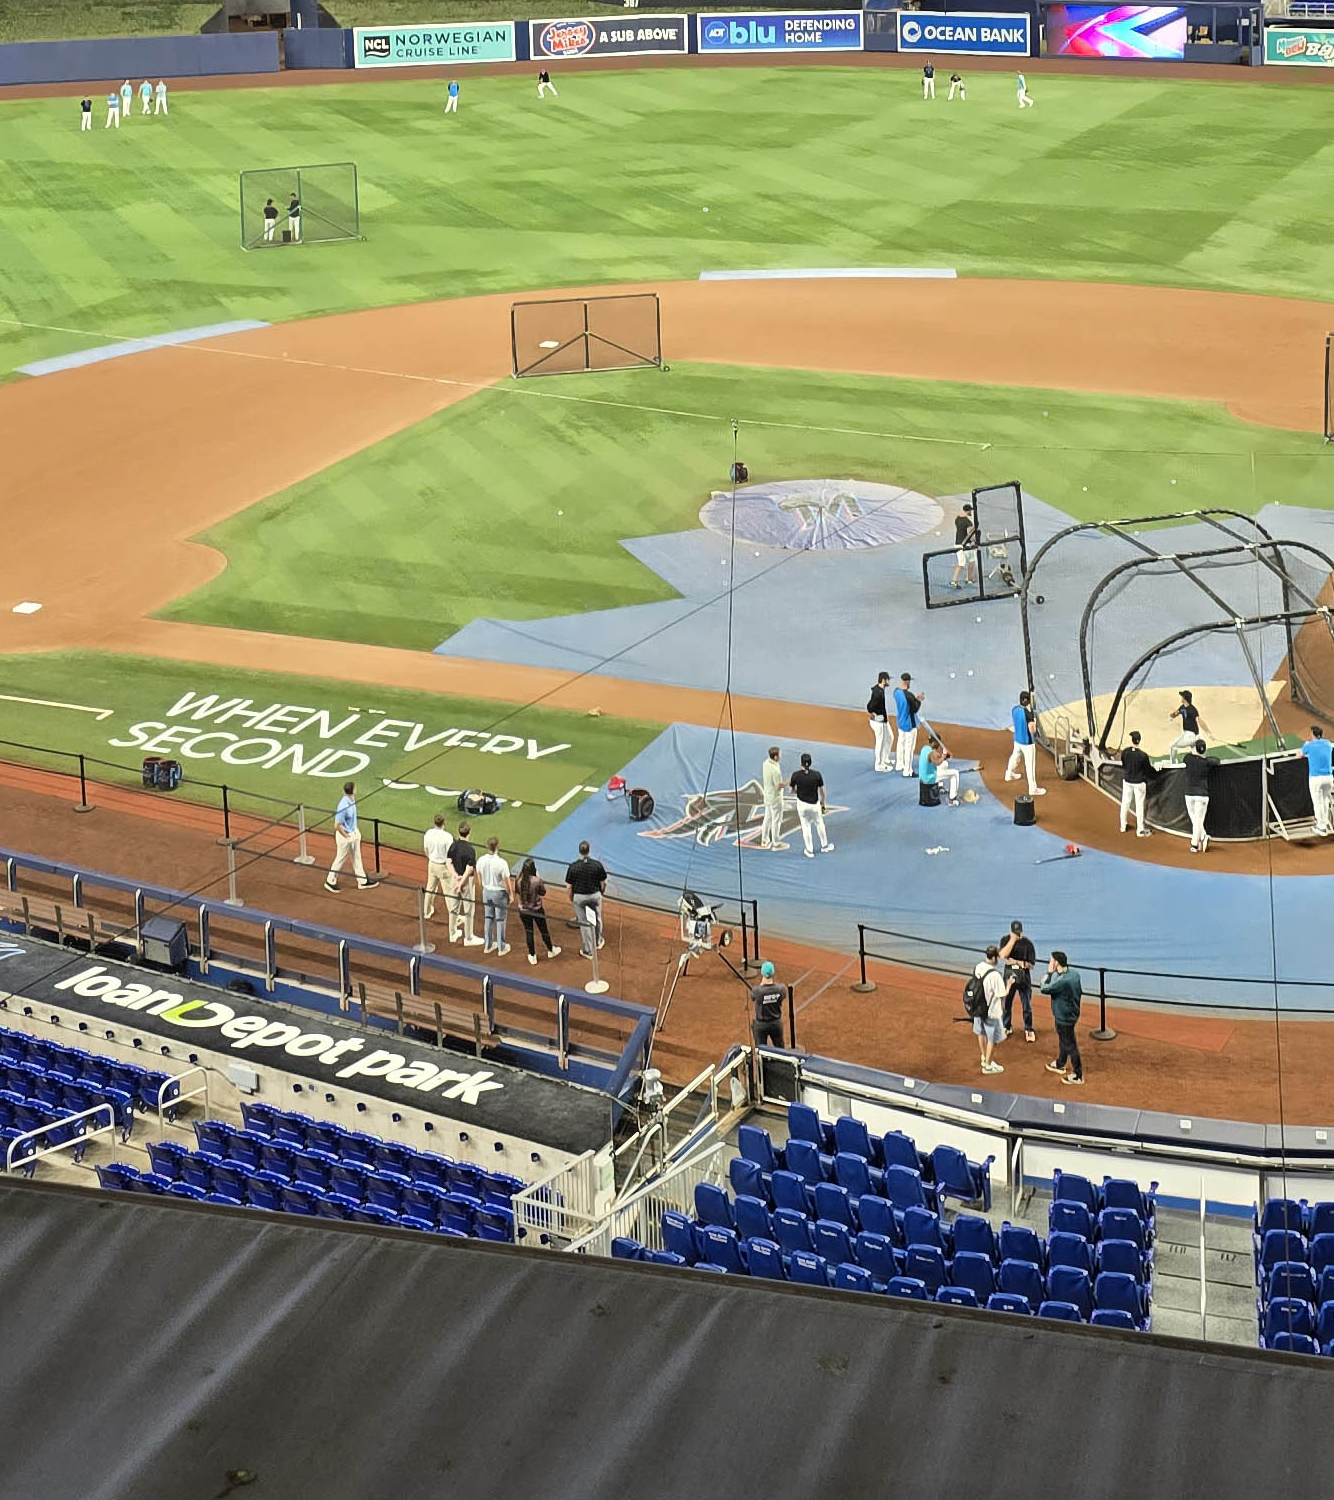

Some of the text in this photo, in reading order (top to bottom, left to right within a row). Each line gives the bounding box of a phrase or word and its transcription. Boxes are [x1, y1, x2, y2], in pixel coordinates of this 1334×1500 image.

[730, 20, 776, 44] blu
[785, 31, 823, 44] HOME
[784, 18, 856, 31] DEFENDING
[395, 30, 507, 46] NORWEGIAN
[547, 25, 588, 42] Jersey
[599, 28, 677, 43] A SUB ABOVE
[924, 26, 1024, 43] OCEAN BANK
[364, 38, 389, 51] NCL
[396, 46, 479, 58] CRUISE LINE
[165, 691, 357, 740] WHEN
[108, 720, 371, 779] SECOND
[54, 965, 505, 1106] loanDepot park
